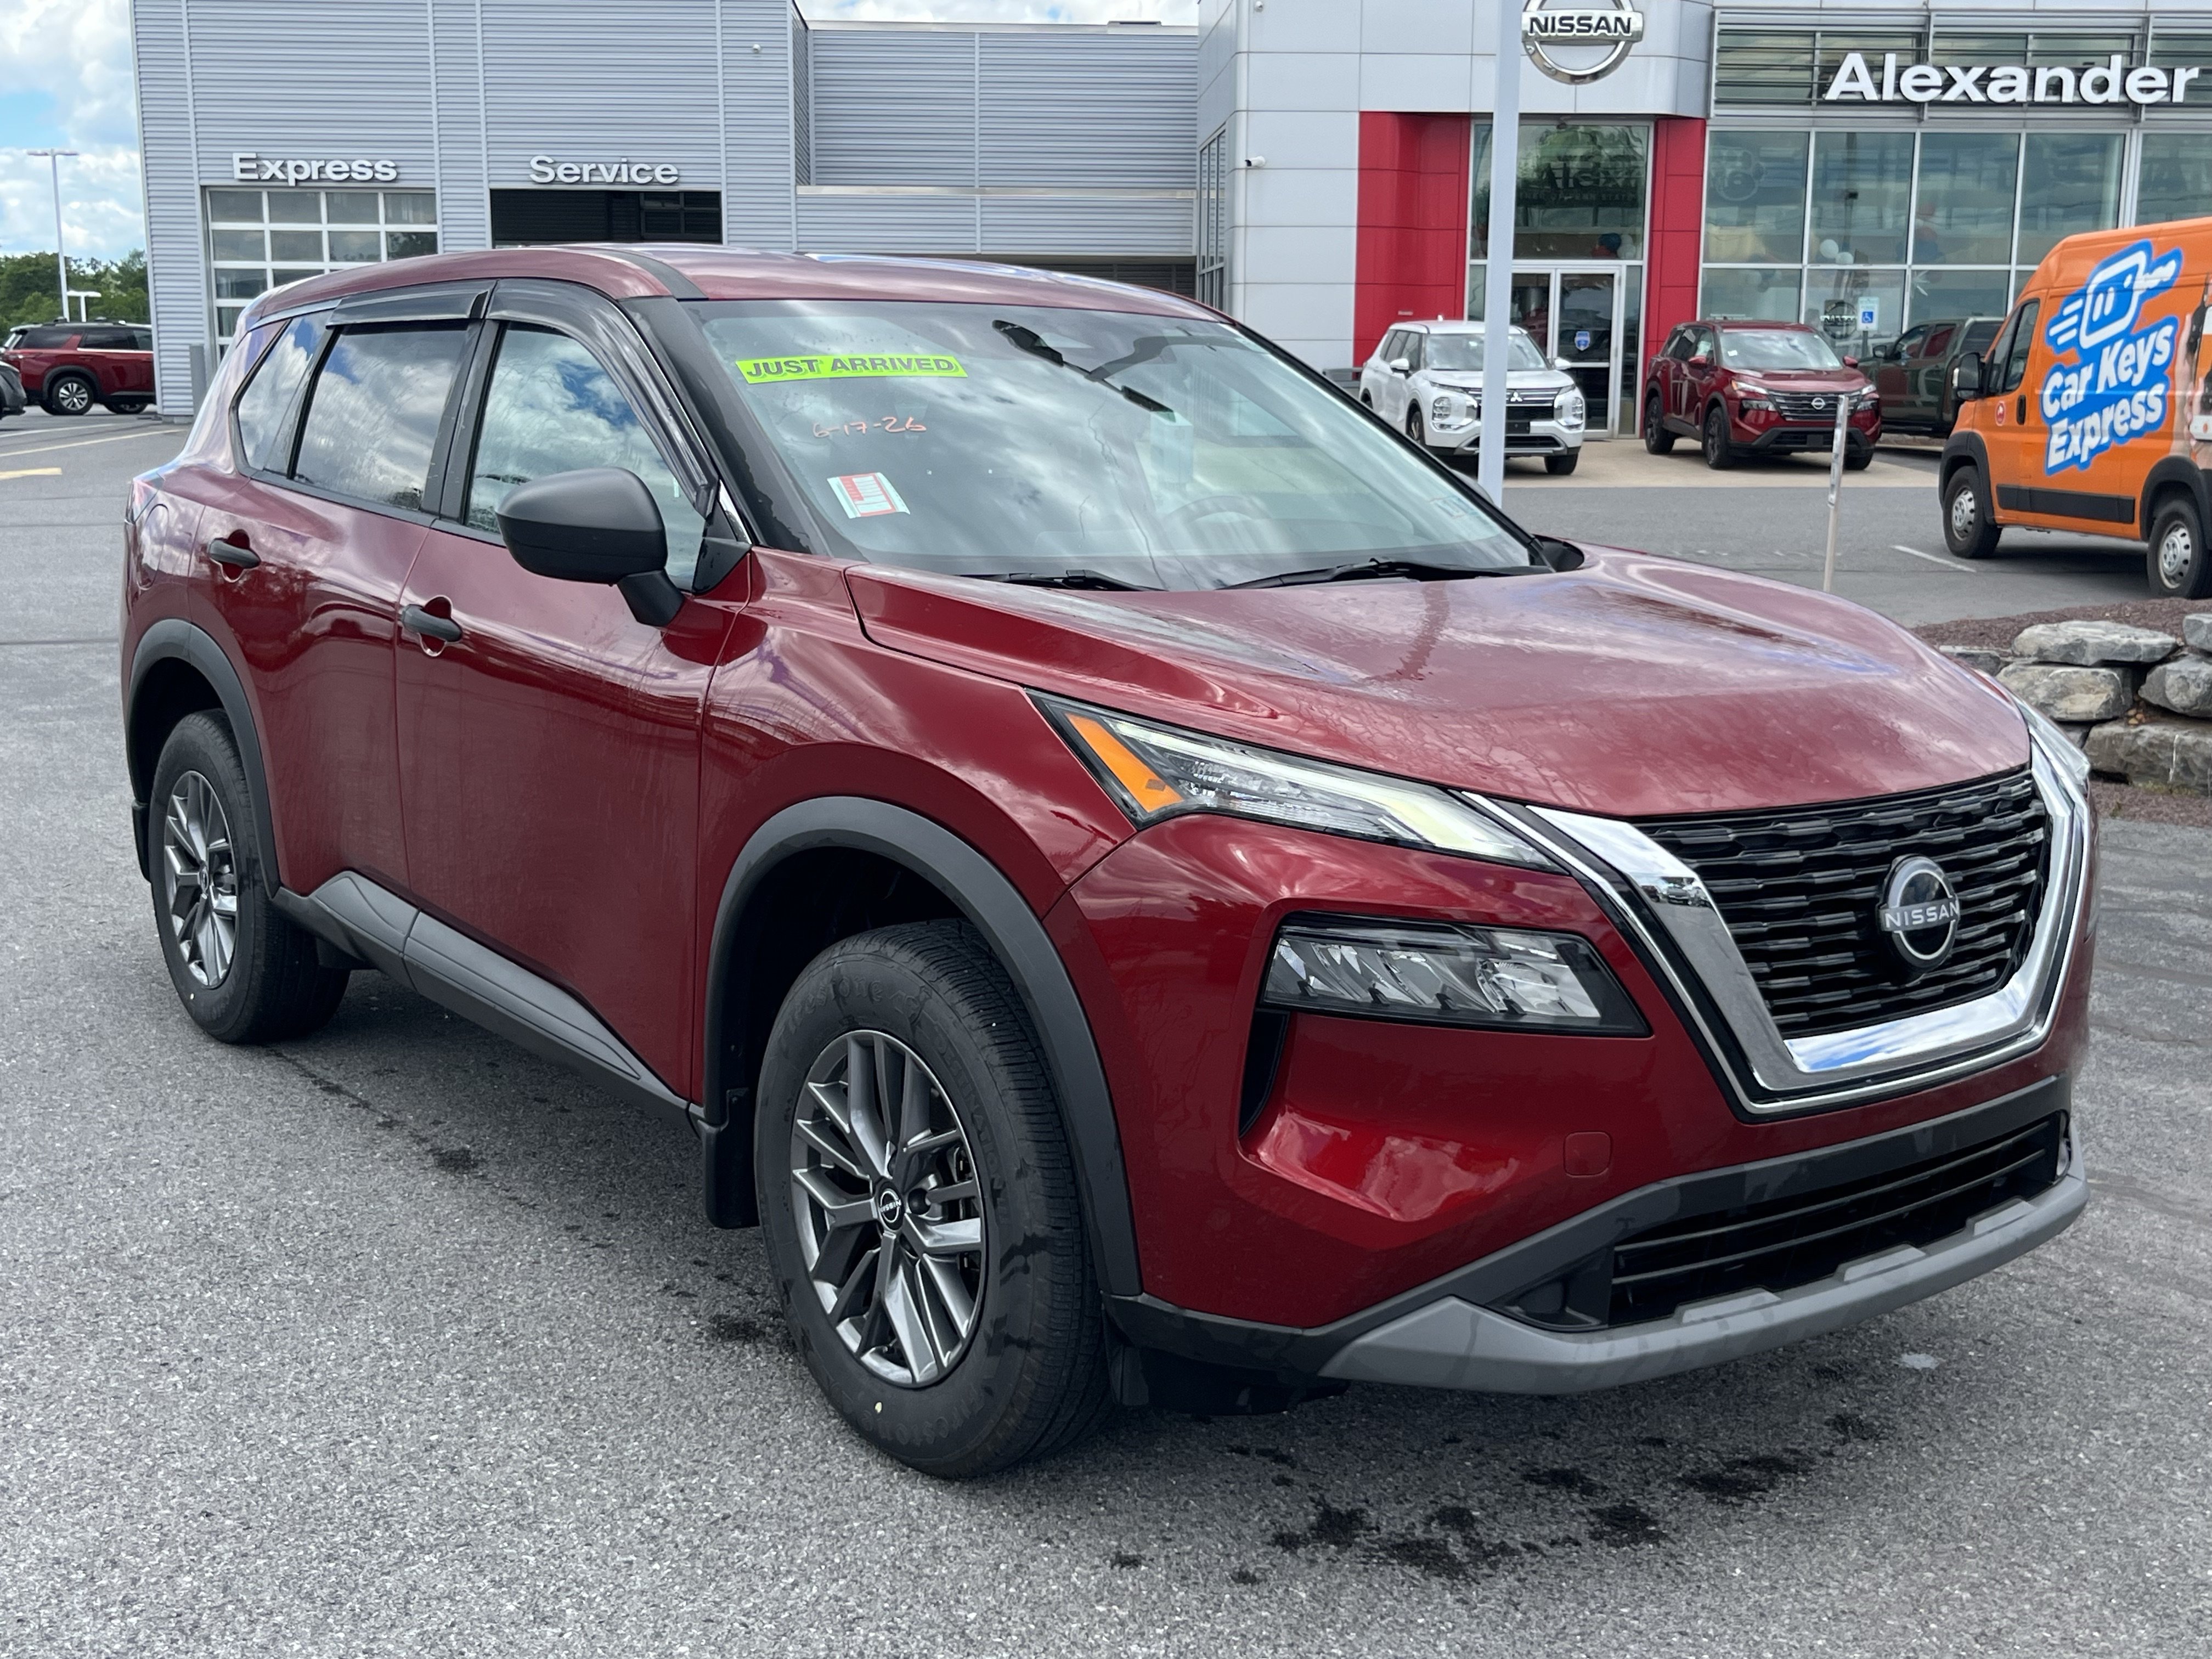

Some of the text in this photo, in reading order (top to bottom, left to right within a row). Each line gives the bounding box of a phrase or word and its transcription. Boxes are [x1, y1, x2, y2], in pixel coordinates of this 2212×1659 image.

[1529, 15, 1632, 35] NISSAN
[1824, 52, 2200, 104] Alexander
[233, 153, 398, 187] Express
[529, 155, 679, 184] Service
[747, 358, 957, 378] JUST ARRIVED
[2042, 325, 2174, 418] Car Keys
[2047, 383, 2165, 470] Express
[1885, 902, 1960, 928] NISSAN
